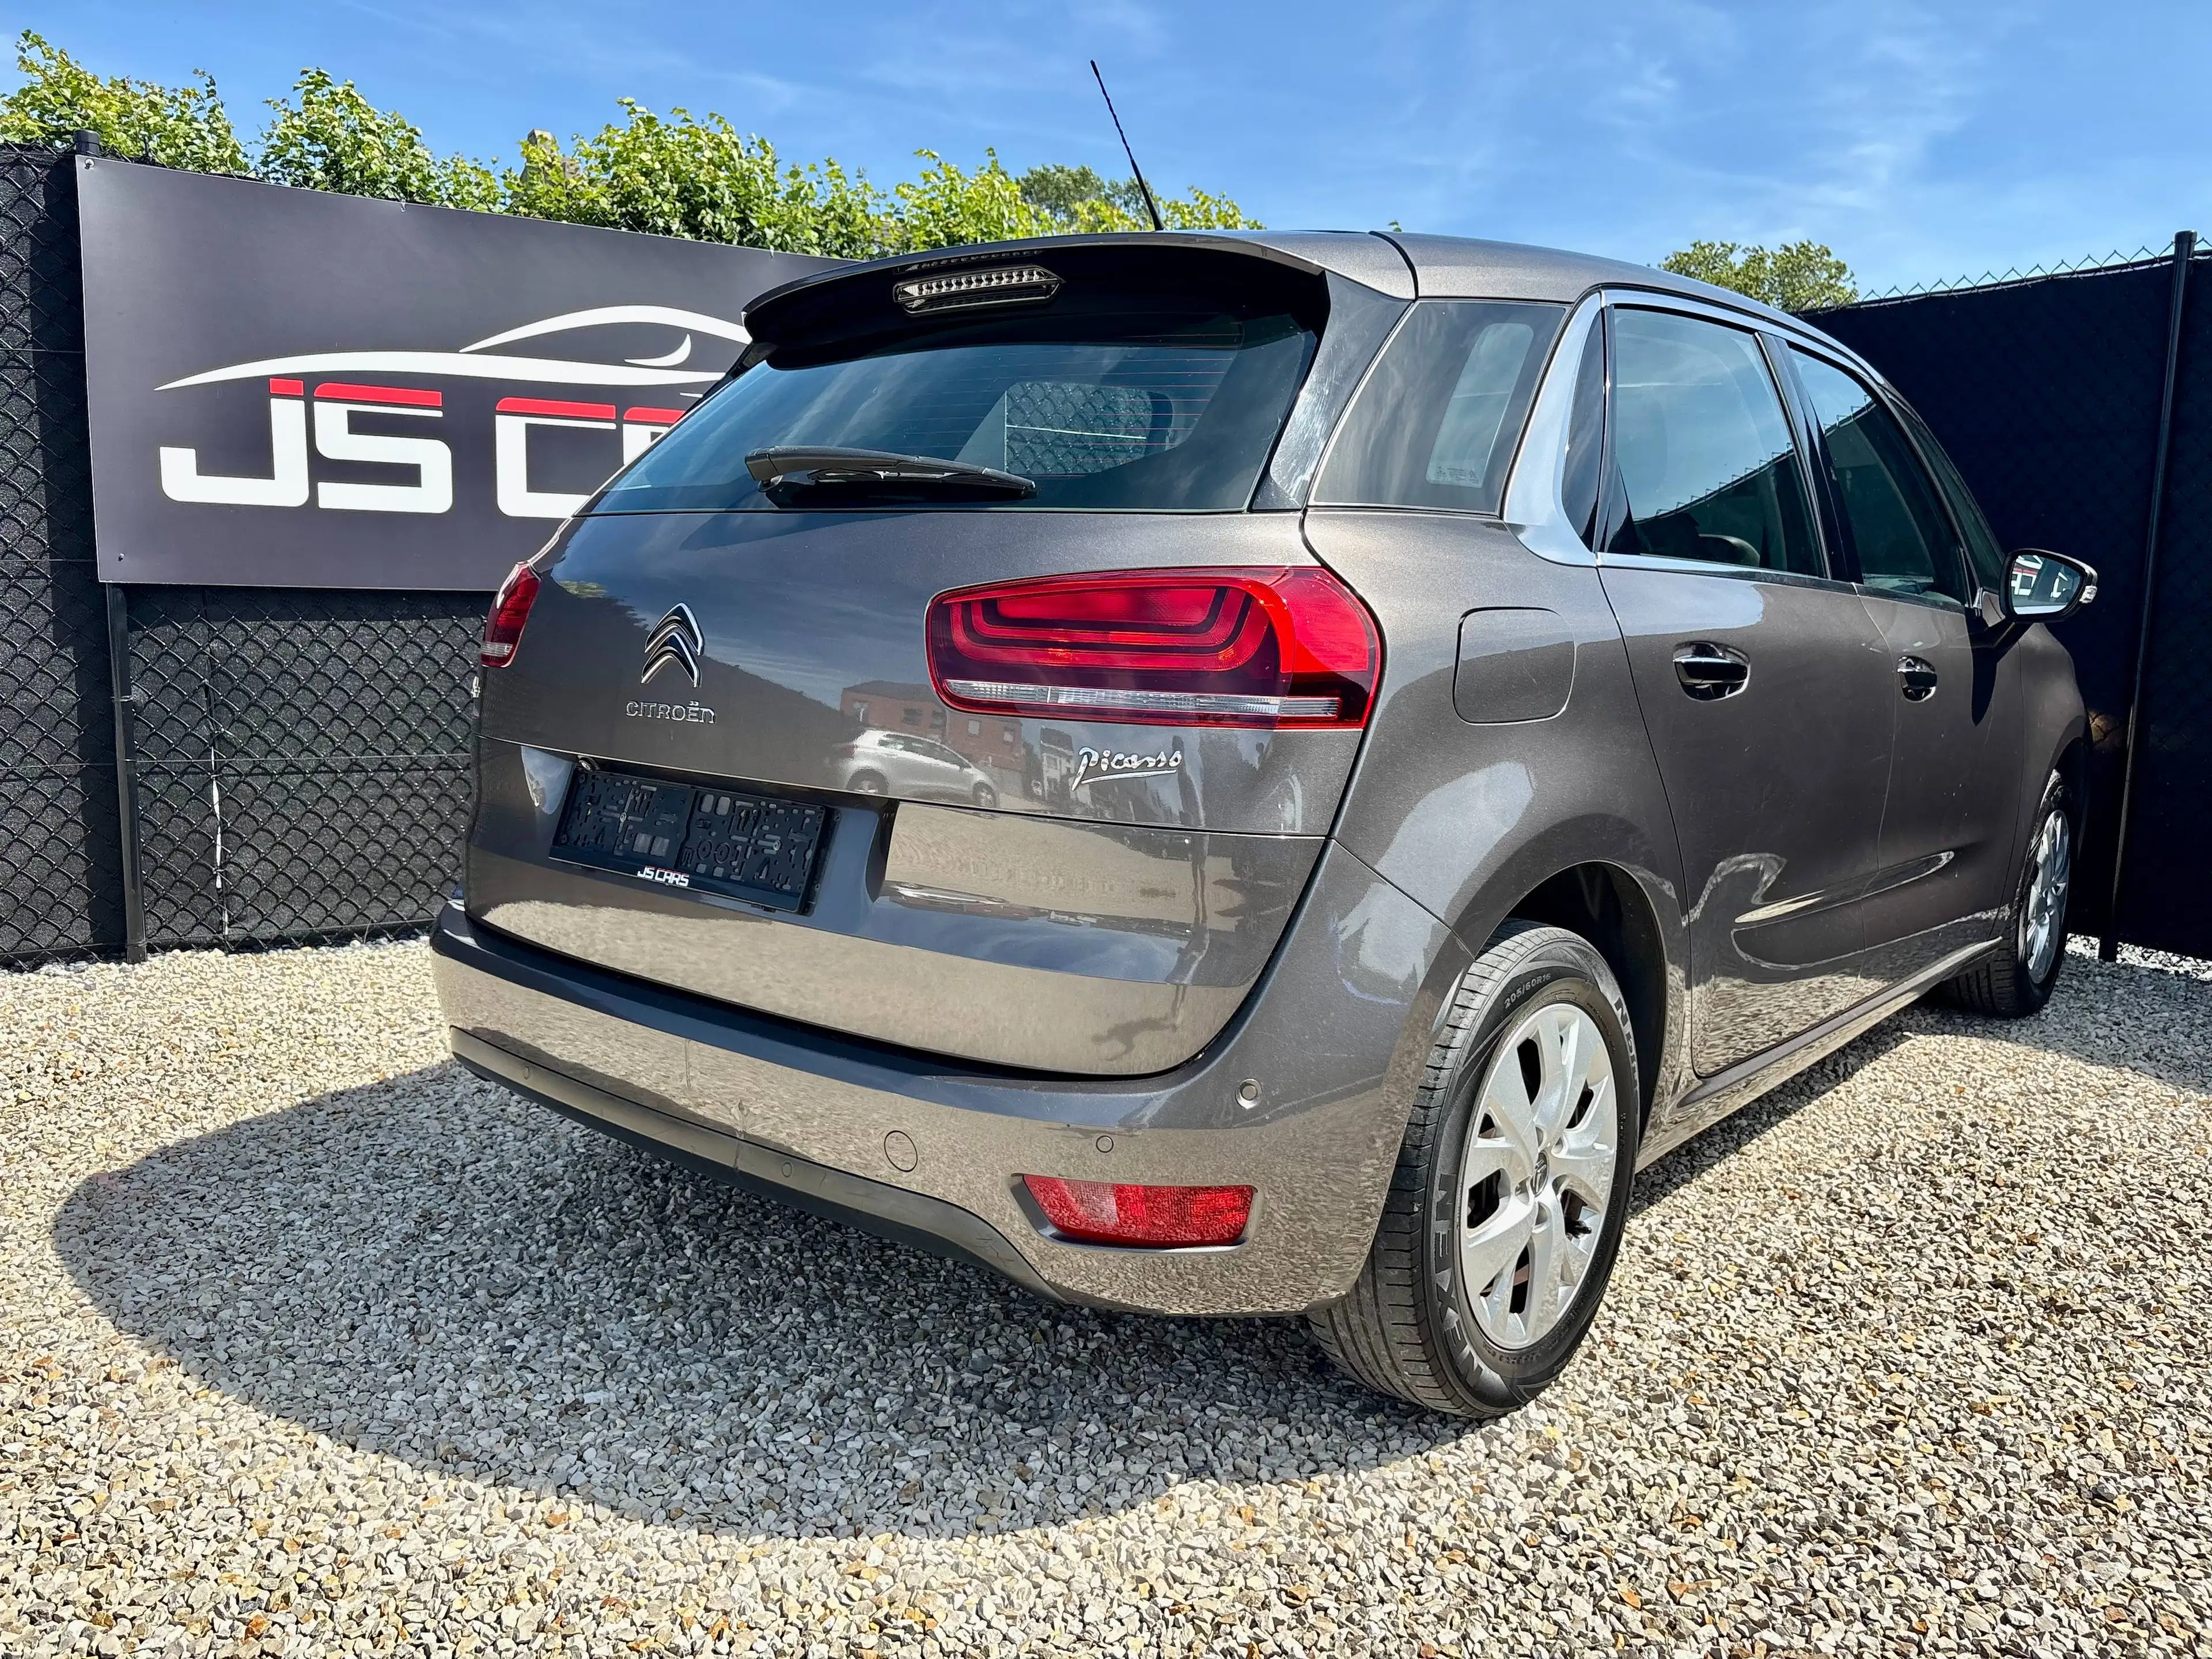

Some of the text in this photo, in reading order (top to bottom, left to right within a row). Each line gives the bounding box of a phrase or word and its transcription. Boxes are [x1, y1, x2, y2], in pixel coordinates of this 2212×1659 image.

[160, 377, 453, 514] JS
[626, 700, 716, 724] CITROËN
[1071, 746, 1183, 791] Picasso
[637, 865, 690, 887] JS CARS
[1503, 972, 1551, 1009] 205/60R16
[1434, 1173, 1484, 1388] NEXEN
